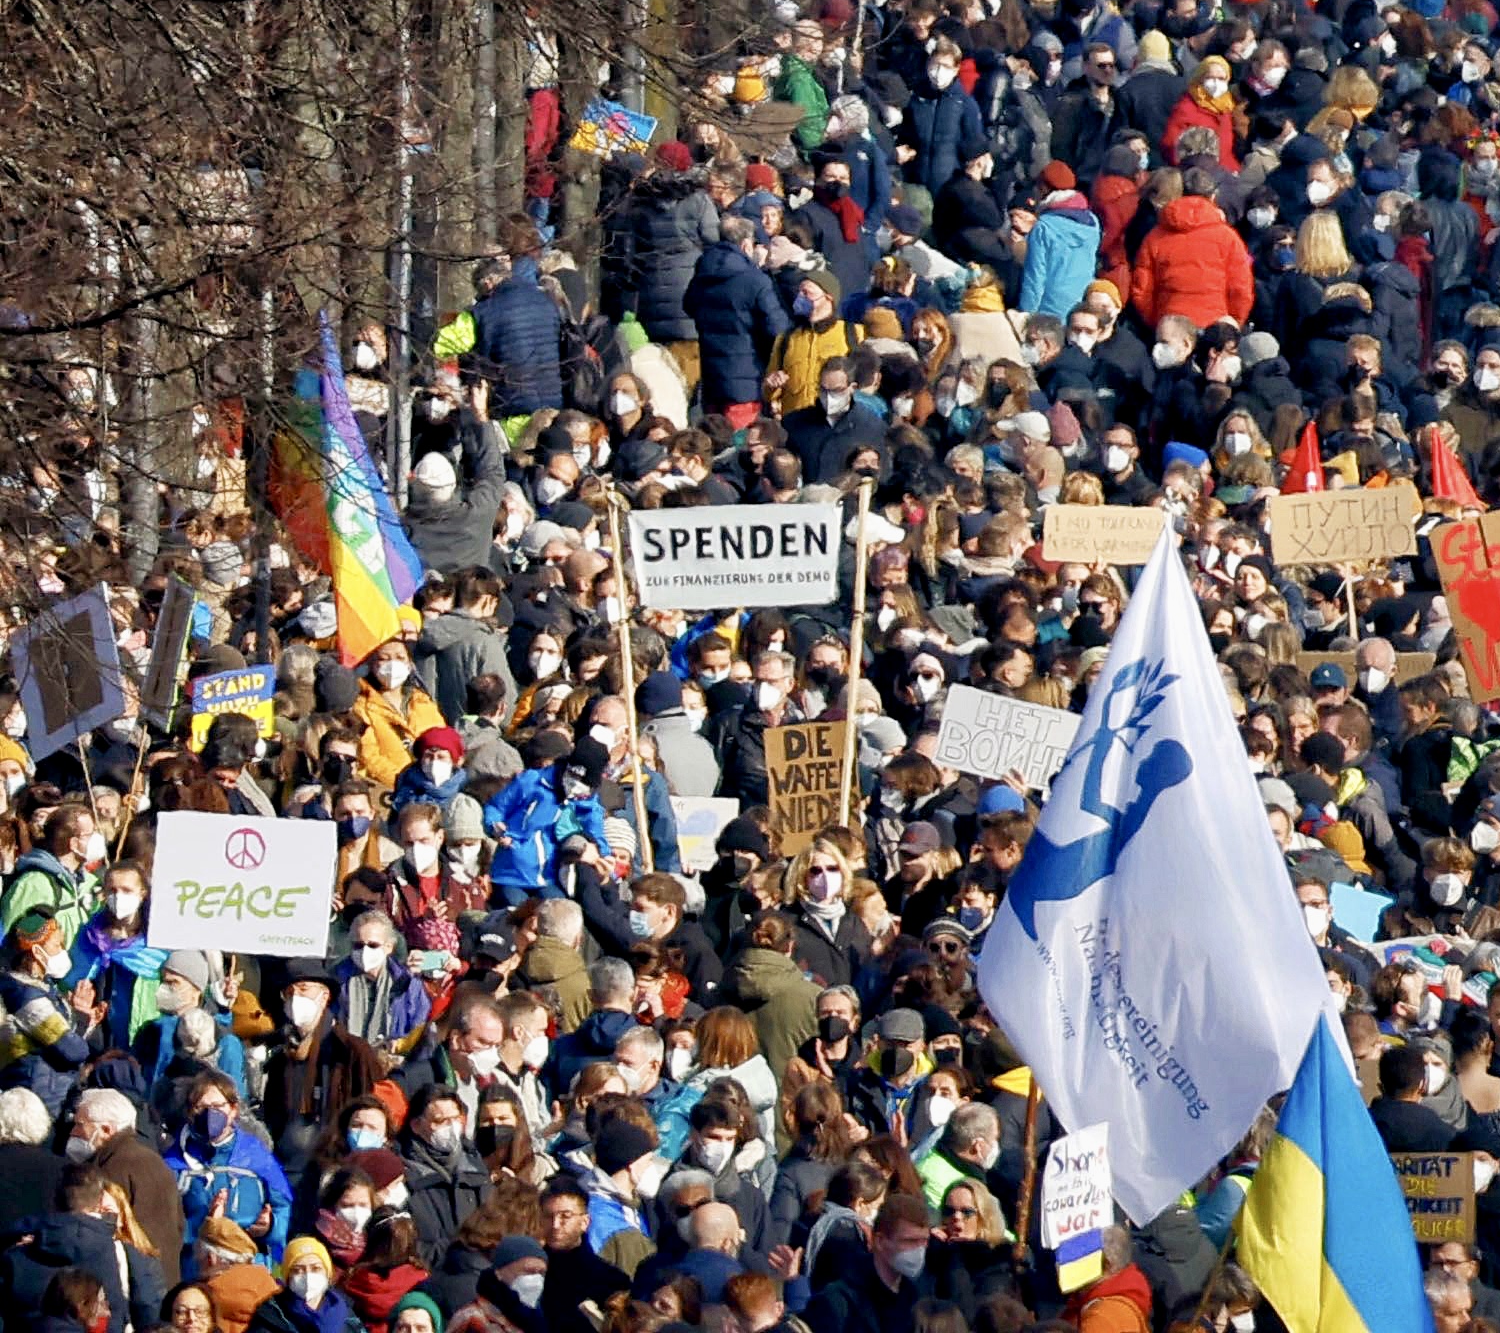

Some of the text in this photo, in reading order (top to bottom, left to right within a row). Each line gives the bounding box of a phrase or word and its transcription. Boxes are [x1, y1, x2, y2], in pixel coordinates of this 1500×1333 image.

[1291, 496, 1398, 527] ПУТИН
[642, 522, 828, 562] SPENDEN
[645, 571, 831, 587] ZUR FINANZIERUNG DER DEMO
[202, 674, 265, 699] STAND
[975, 695, 1059, 742] НЕТ
[784, 726, 832, 762] DIE
[174, 880, 311, 921] PEACE
